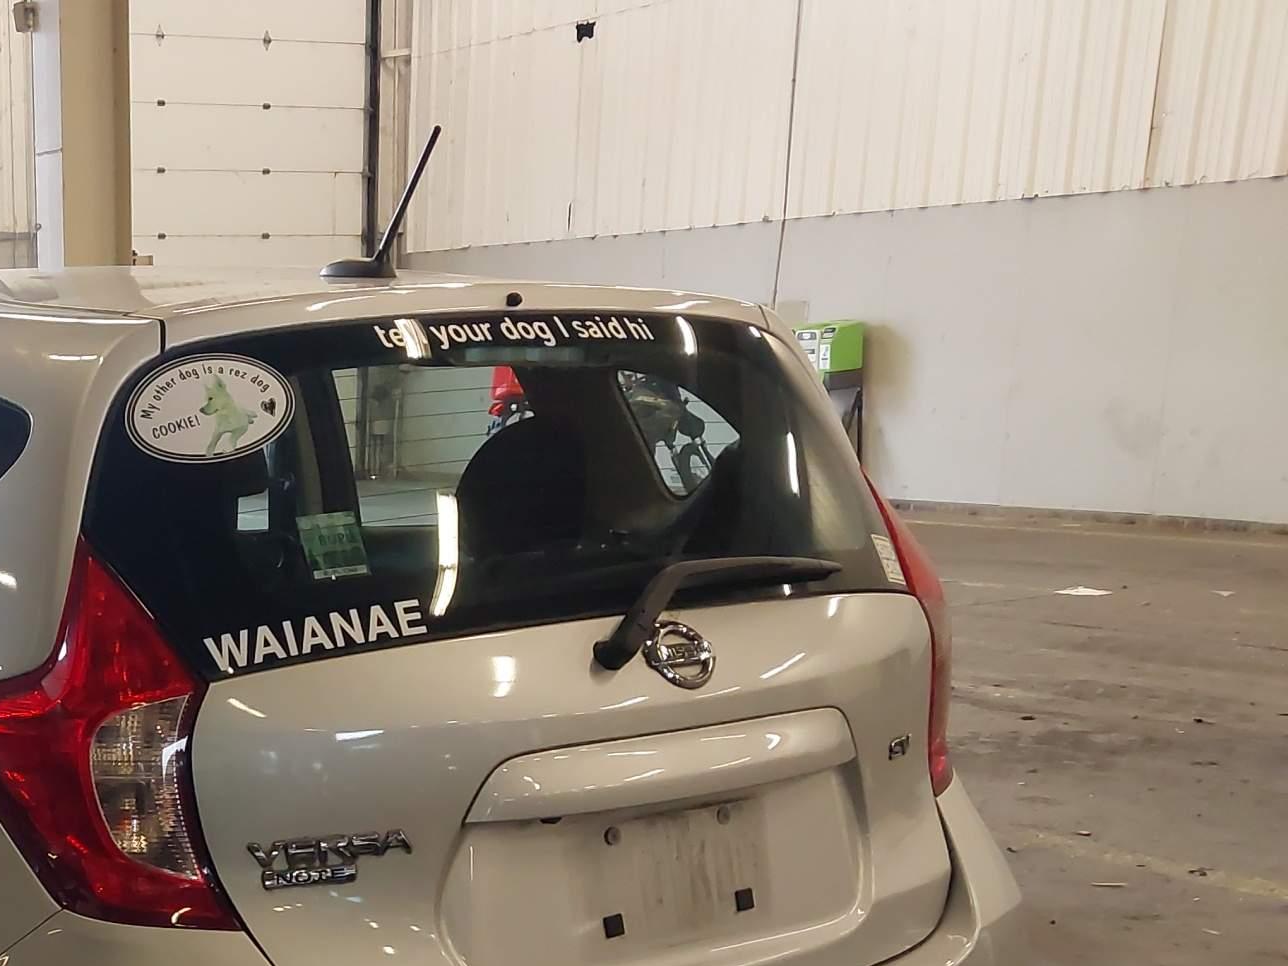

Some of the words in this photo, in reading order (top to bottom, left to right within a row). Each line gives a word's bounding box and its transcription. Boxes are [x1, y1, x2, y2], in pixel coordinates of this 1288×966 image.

[429, 323, 492, 350] your
[500, 317, 557, 347] dog
[553, 315, 570, 338] I
[571, 316, 627, 339] said
[623, 317, 655, 340] hi
[140, 402, 161, 420] My
[152, 377, 177, 402] other
[178, 368, 200, 380] dog
[218, 366, 224, 374] a
[229, 368, 247, 379] rez
[250, 374, 270, 393] dog
[152, 414, 201, 440] COOKIE!
[203, 599, 428, 674] WAIANAE
[247, 828, 412, 869] VERSA
